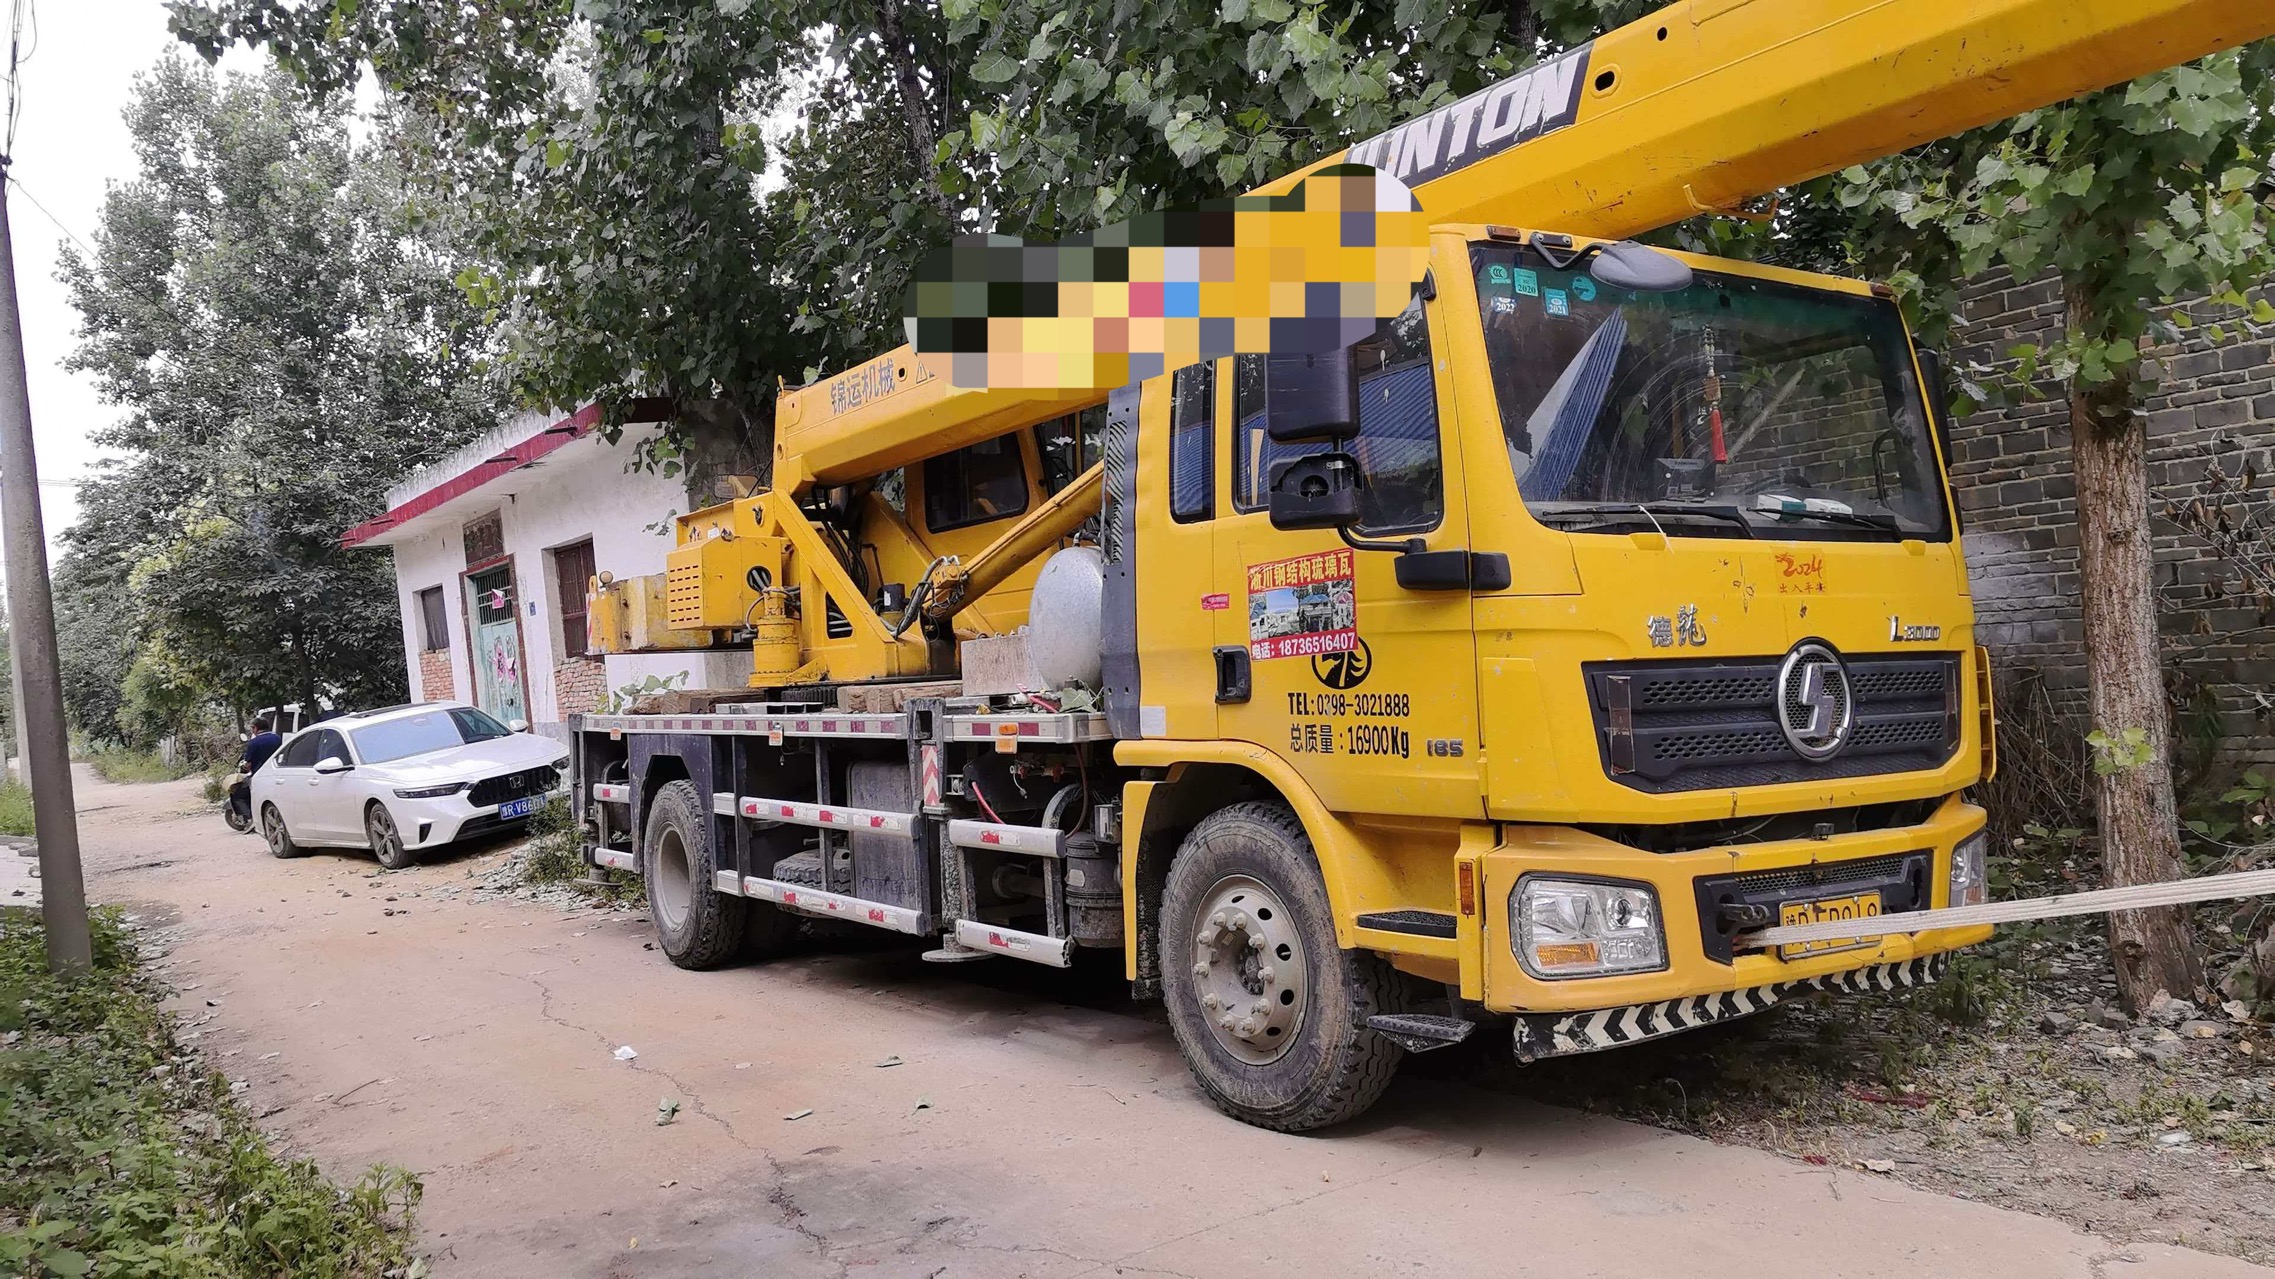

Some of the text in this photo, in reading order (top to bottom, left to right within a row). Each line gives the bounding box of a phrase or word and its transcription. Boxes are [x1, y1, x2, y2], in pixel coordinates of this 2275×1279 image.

[1517, 284, 1536, 294] 2020
[1549, 304, 1566, 314] 2021
[831, 357, 896, 416] 锦运机械
[1775, 553, 1823, 579] 2024
[1779, 582, 1826, 595] 出入平安
[1427, 739, 1464, 757] 185
